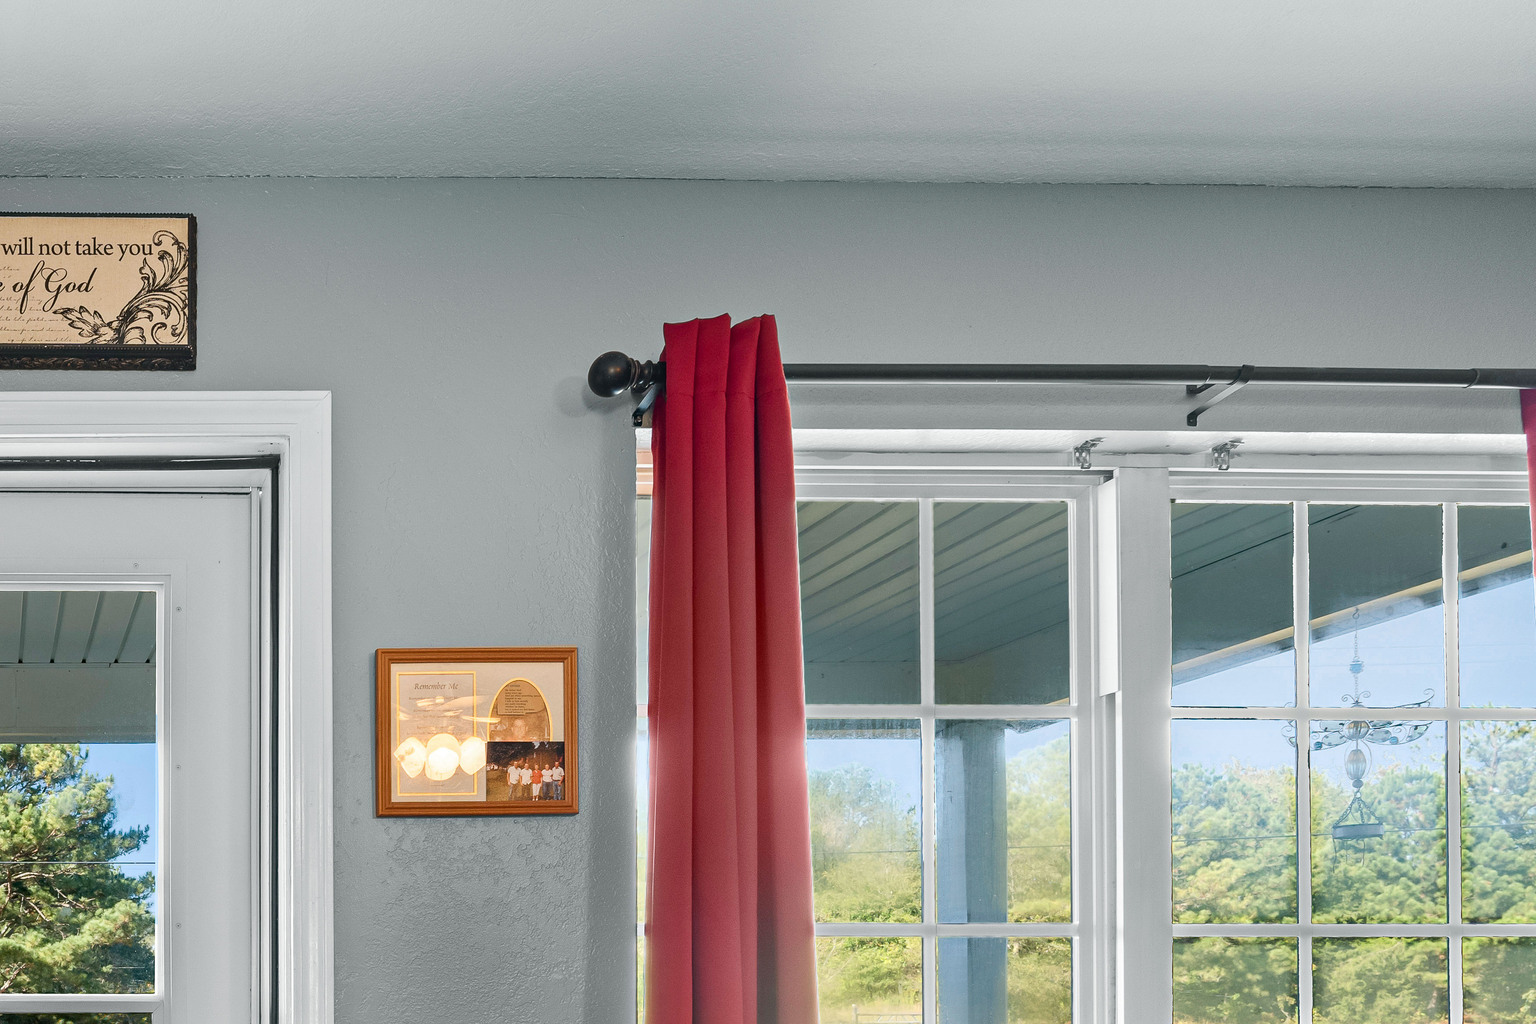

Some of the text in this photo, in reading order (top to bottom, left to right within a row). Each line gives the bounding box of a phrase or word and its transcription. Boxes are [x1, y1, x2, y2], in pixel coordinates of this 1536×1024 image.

[1, 236, 35, 256] will
[38, 240, 72, 256] not
[75, 237, 114, 256] take
[117, 242, 154, 262] you
[12, 260, 46, 314] of
[40, 267, 98, 312] God
